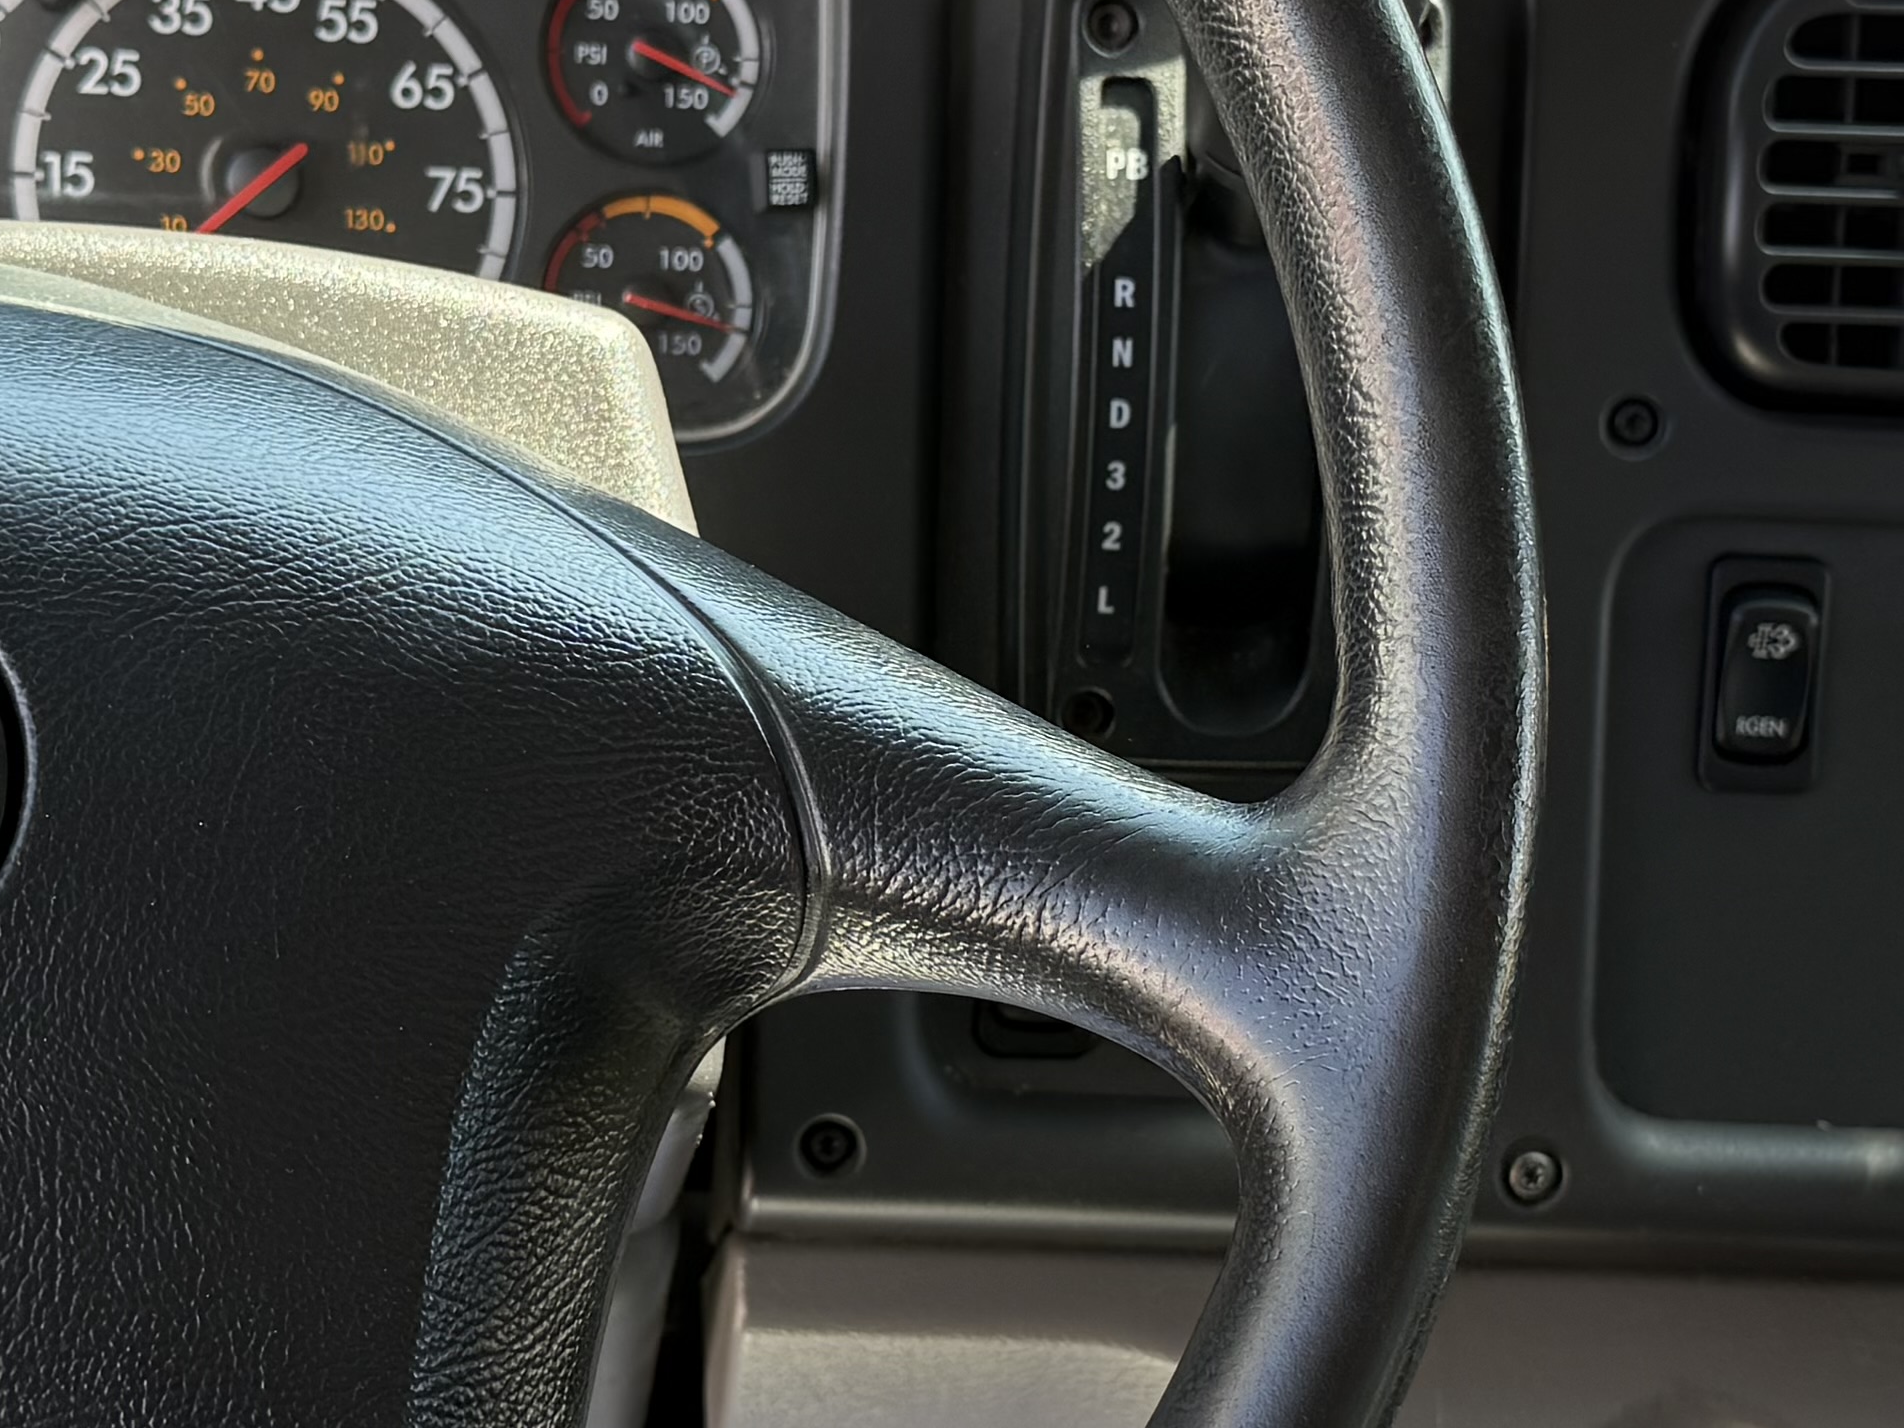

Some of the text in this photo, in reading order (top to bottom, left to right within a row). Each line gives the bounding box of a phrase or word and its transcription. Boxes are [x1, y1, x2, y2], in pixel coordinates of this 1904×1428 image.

[574, 41, 608, 65] PSI
[76, 49, 142, 96] 25
[244, 69, 276, 94] 70
[307, 88, 340, 113] 90
[391, 63, 455, 111] 65
[589, 80, 609, 106] 0
[663, 81, 709, 110] 150
[182, 91, 216, 117] 50
[634, 127, 665, 148] AIR
[149, 148, 182, 173] 30
[348, 140, 384, 166] 110
[1105, 147, 1148, 182] PB
[41, 151, 95, 198] 15
[426, 168, 485, 214] 75
[345, 207, 385, 232] 130
[582, 243, 614, 269] 50
[659, 245, 704, 272] 100
[1114, 278, 1136, 308] R
[658, 332, 702, 356] 150
[1112, 338, 1134, 369] N
[1109, 400, 1131, 430] D
[1105, 460, 1126, 491] 3
[1100, 521, 1122, 551] 2
[1097, 586, 1115, 615] L
